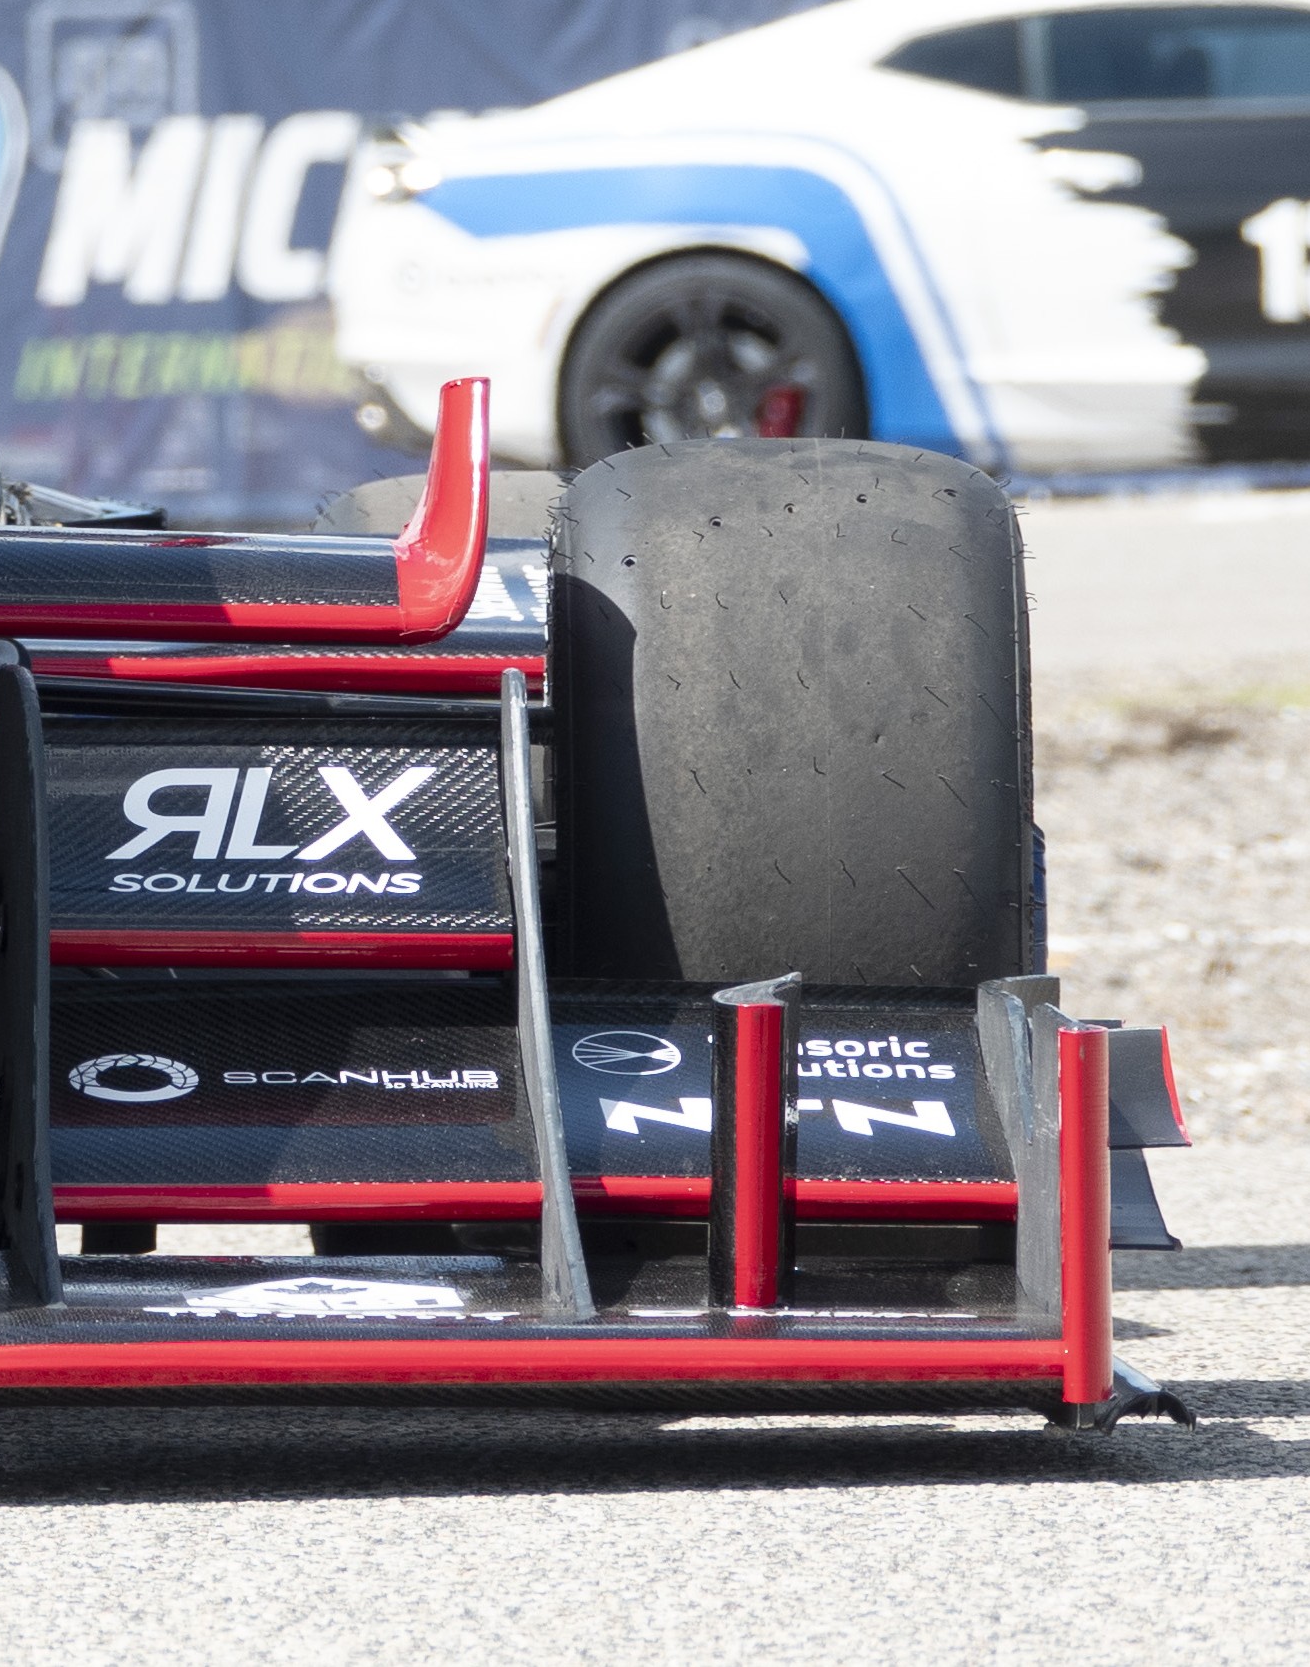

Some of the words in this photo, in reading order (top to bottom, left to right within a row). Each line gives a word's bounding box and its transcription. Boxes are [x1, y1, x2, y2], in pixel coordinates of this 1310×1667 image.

[1239, 197, 1310, 324] 1
[108, 872, 423, 894] SOLUTIONS
[222, 1069, 499, 1085] SCANHUB
